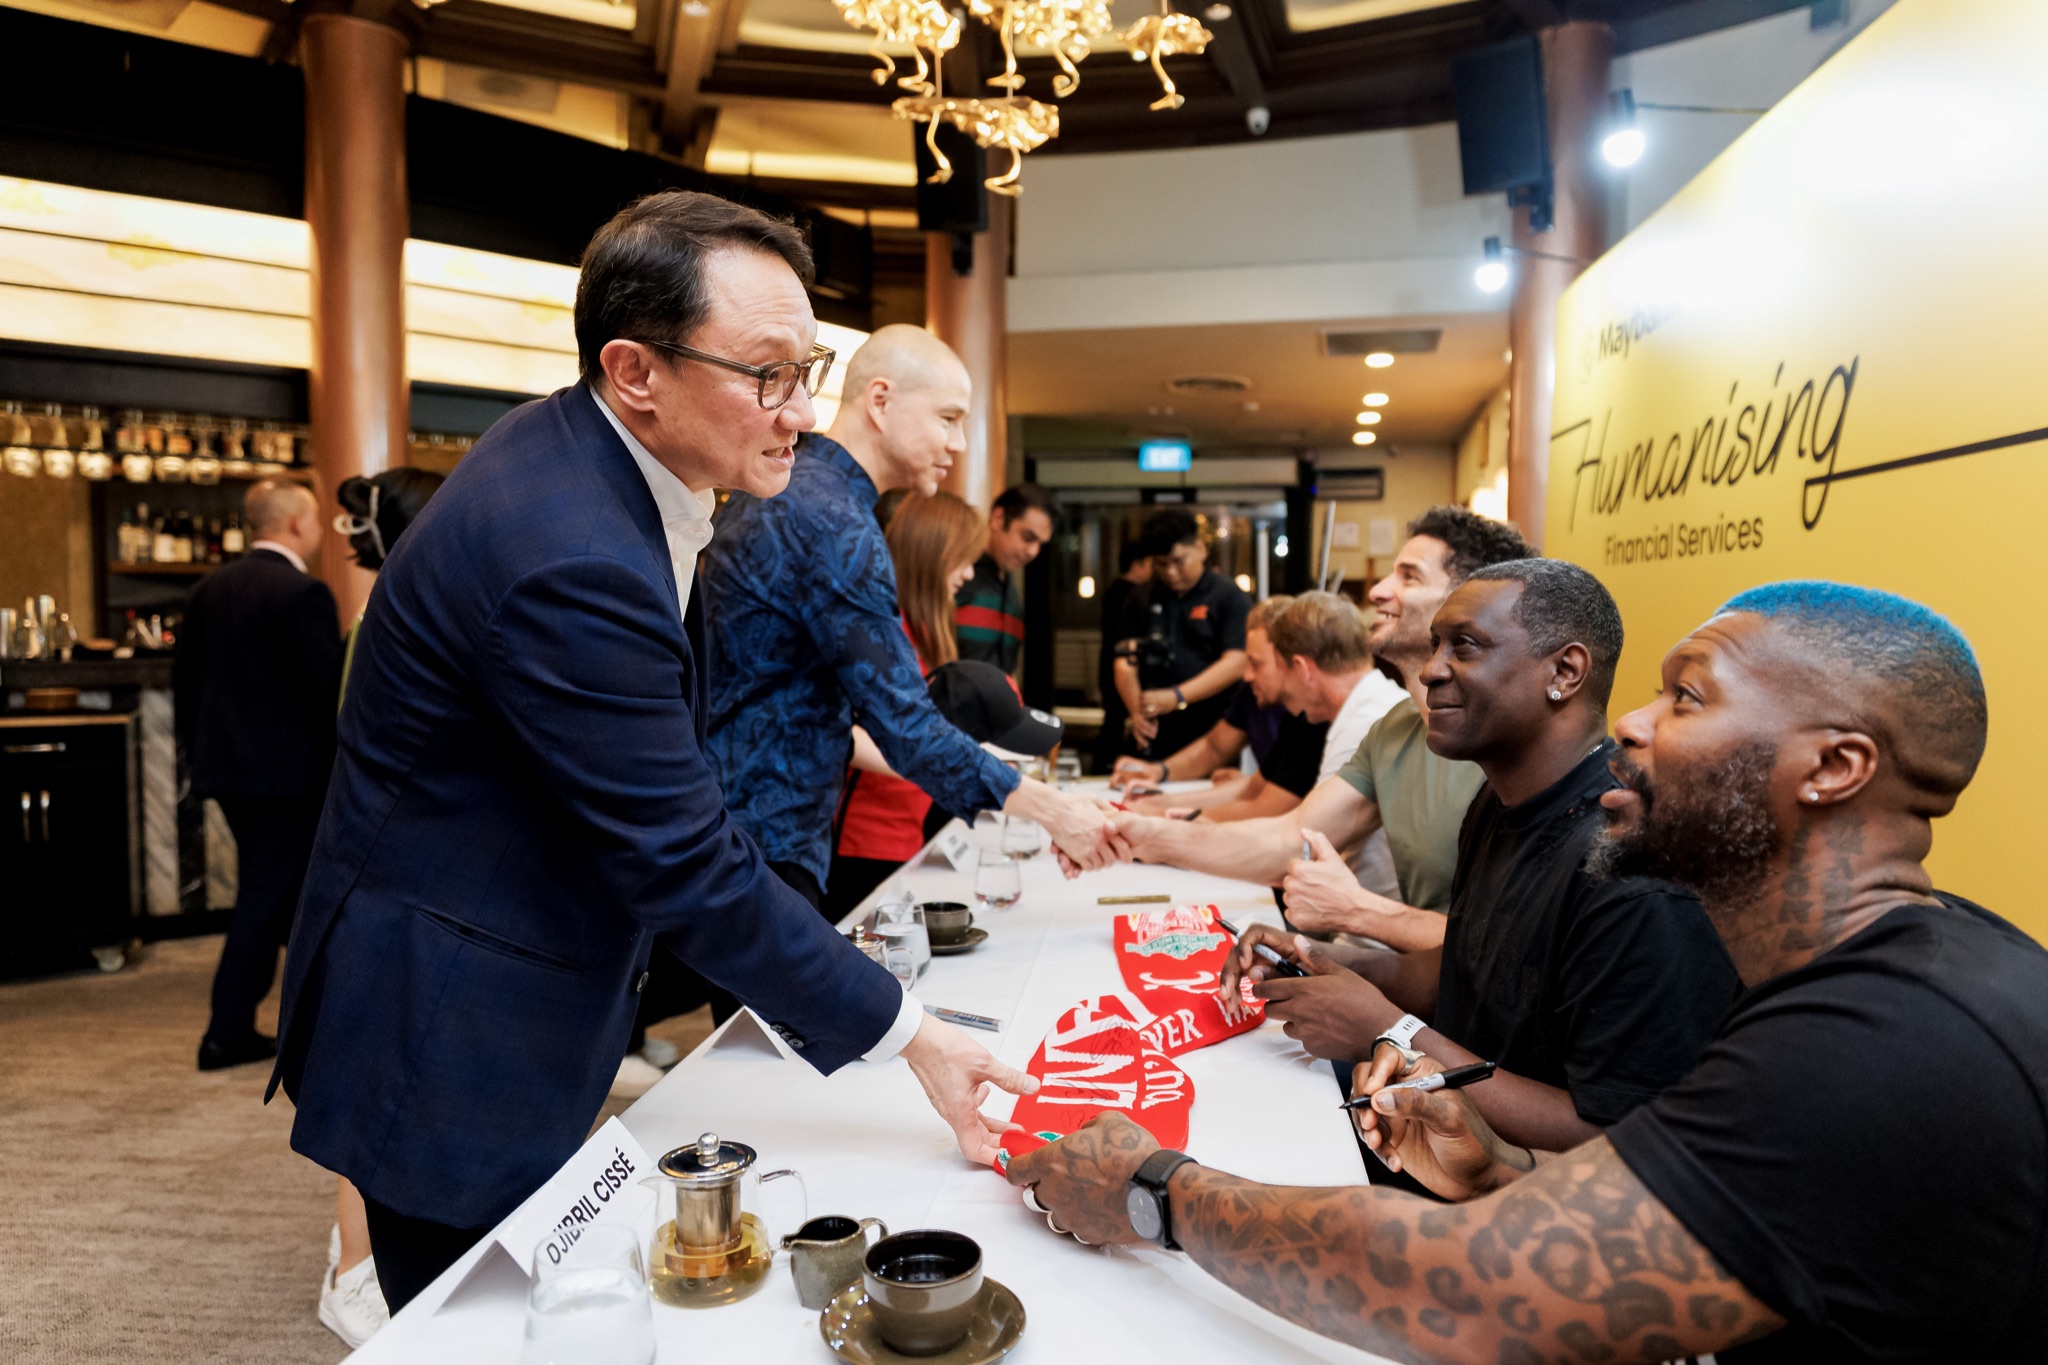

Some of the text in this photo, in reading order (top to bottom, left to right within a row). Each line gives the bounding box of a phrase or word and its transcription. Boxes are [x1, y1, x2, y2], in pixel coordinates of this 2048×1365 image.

[1551, 355, 1859, 534] Humanising
[1605, 511, 1764, 567] Financial Services
[545, 1146, 636, 1266] DJIBRIL CISSÉ
